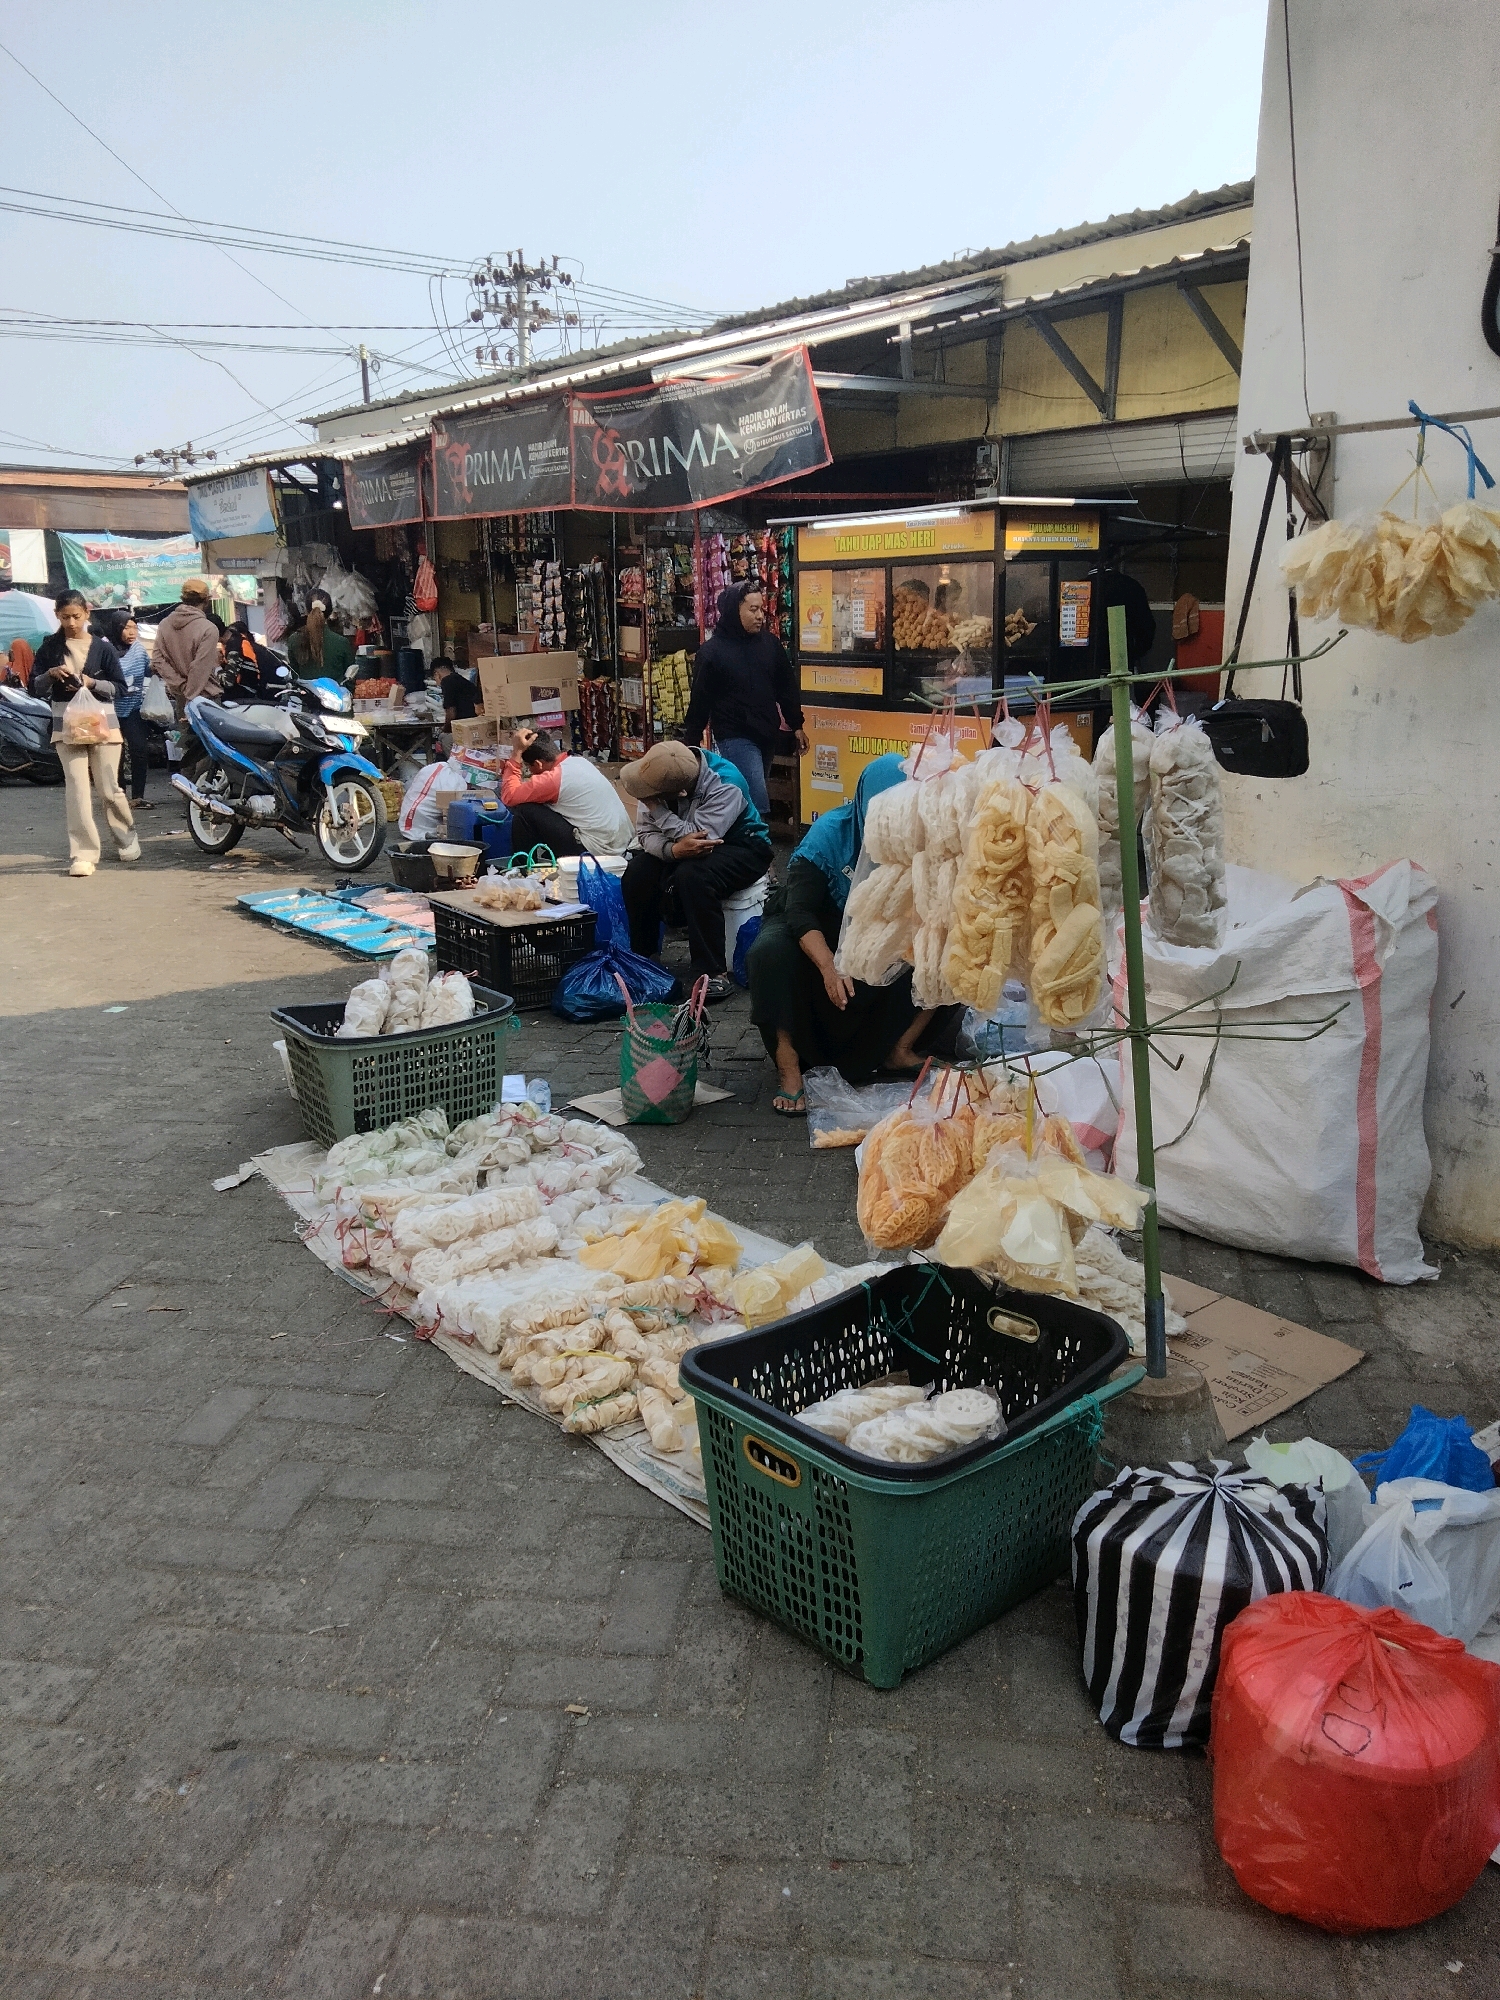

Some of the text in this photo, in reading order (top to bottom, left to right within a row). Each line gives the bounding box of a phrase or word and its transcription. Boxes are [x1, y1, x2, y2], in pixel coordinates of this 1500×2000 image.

[738, 402, 788, 427] HADIR DALAM
[740, 406, 807, 437] KEMASAN KERTAS
[785, 425, 810, 440] SATUAN
[548, 447, 569, 459] KERTAS
[614, 423, 740, 477] PRIMA
[464, 446, 527, 487] PRIMA
[834, 529, 936, 552] TAHU UAP MAS HERI
[848, 736, 870, 754] TAHU
[871, 737, 889, 755] UAP
[889, 738, 909, 758] MAS
[1225, 1375, 1263, 1395] Durian
[1221, 1390, 1246, 1405] Keju
